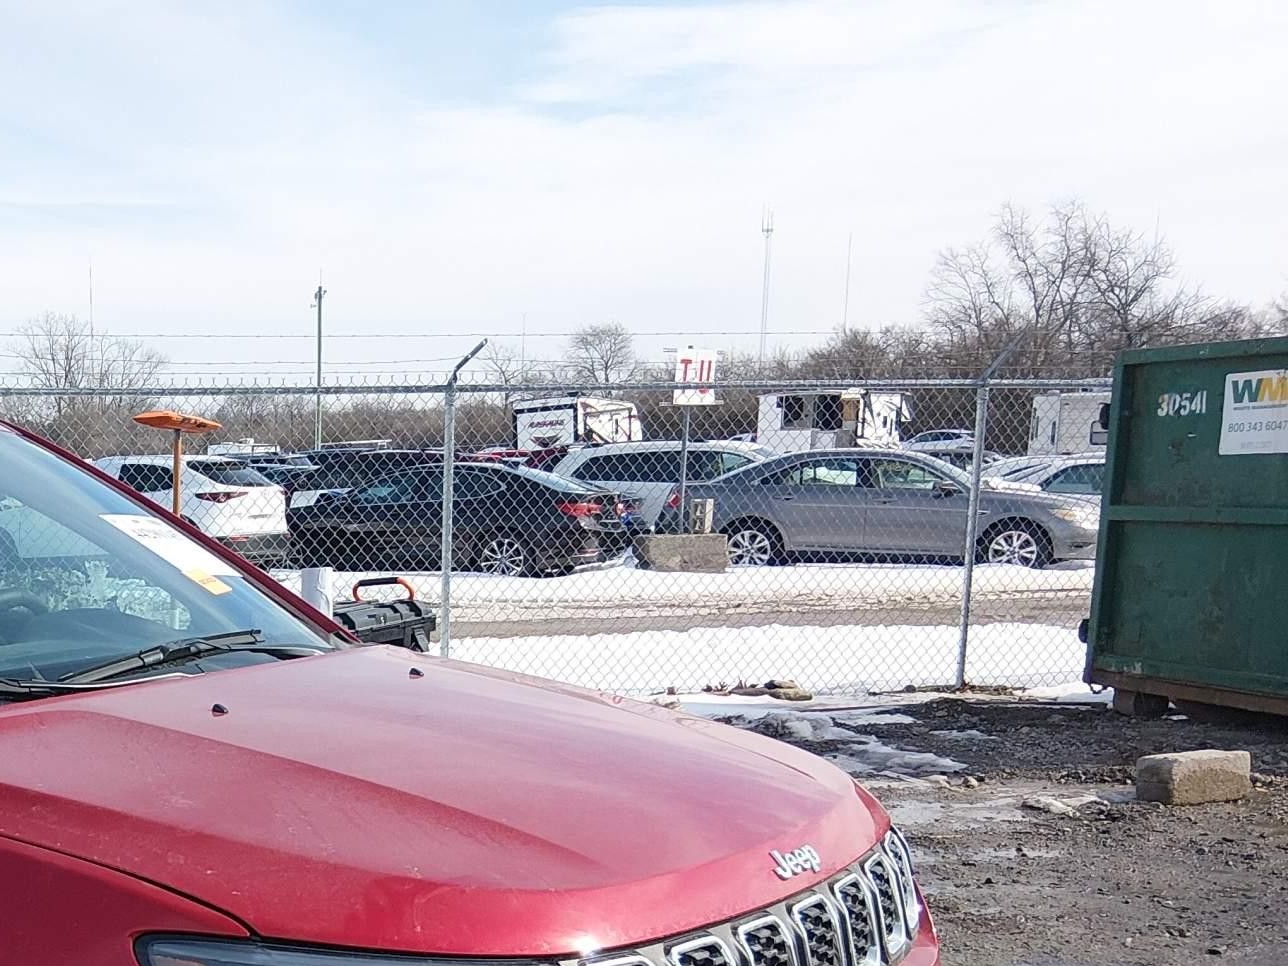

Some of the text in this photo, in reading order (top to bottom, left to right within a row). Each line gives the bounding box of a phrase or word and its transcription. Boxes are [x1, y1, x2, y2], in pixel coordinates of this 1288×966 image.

[1157, 390, 1207, 417] 30541
[1228, 422, 1245, 433] 800
[1246, 421, 1263, 432] 343
[769, 844, 821, 881] Jeep
